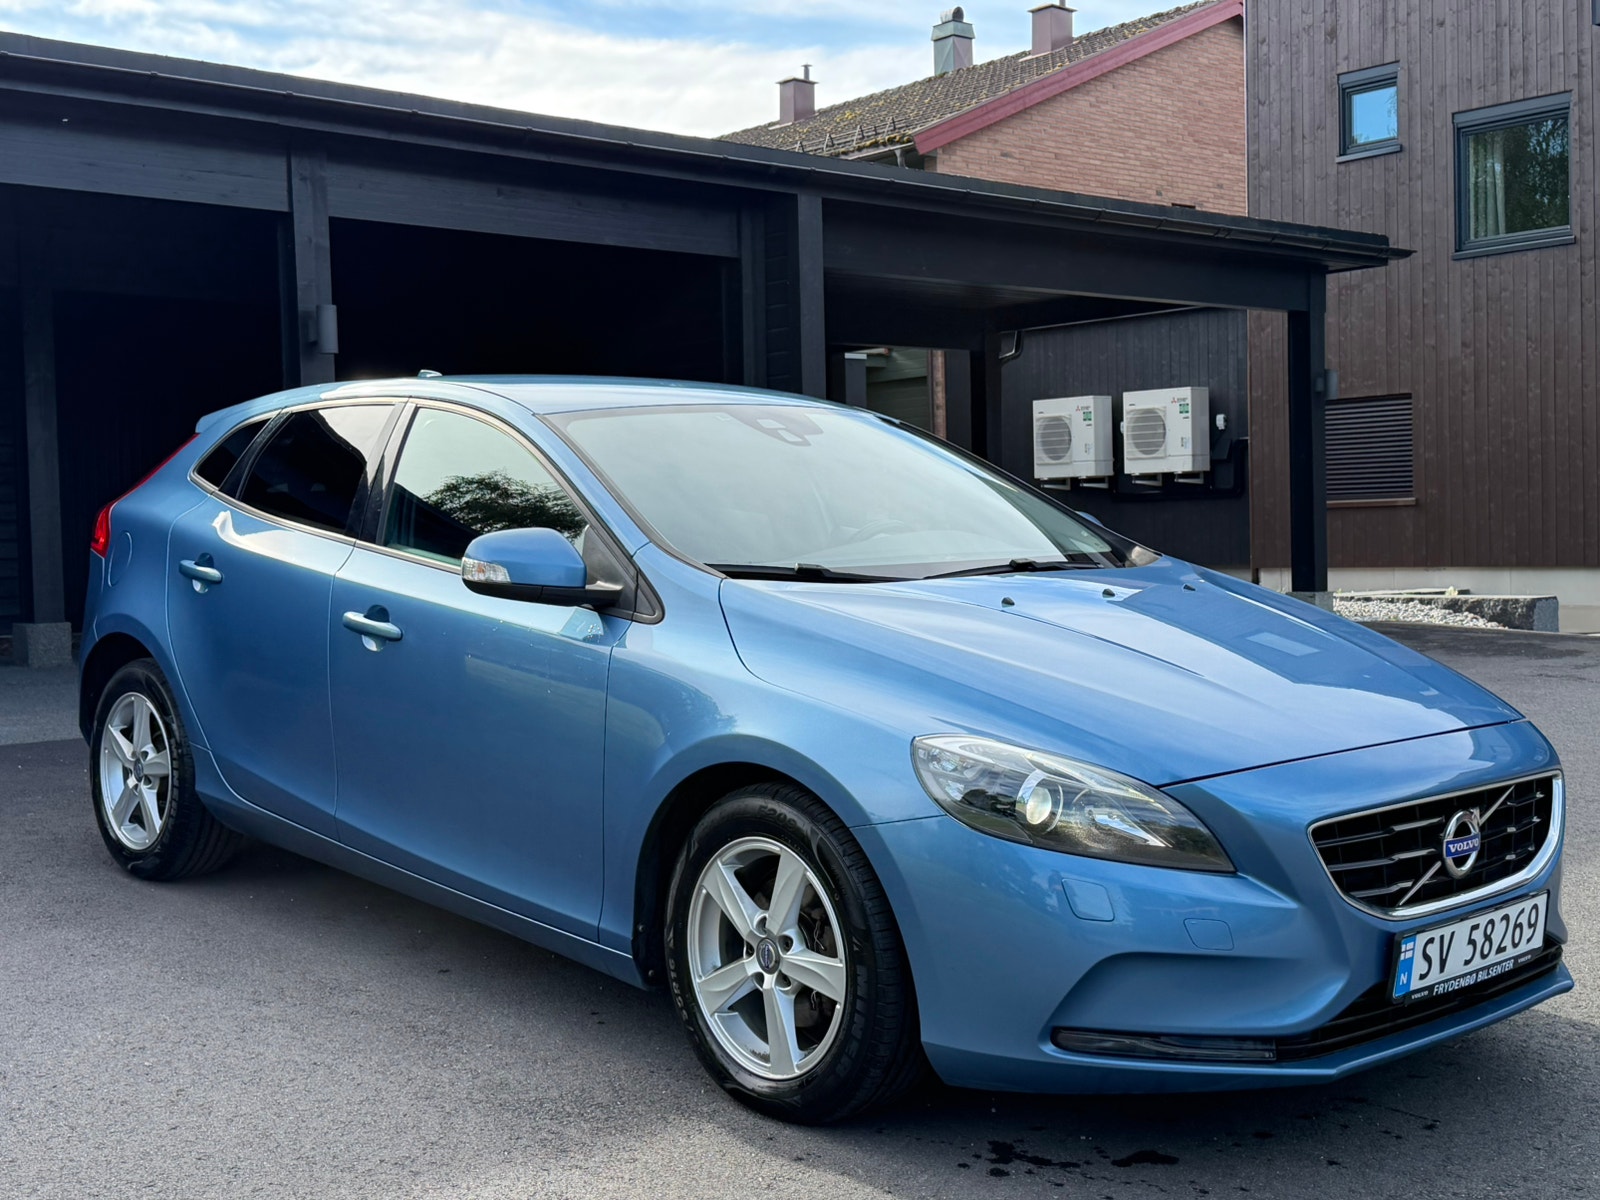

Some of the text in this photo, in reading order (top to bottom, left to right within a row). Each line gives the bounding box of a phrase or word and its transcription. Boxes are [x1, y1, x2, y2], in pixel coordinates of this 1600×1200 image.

[1448, 838, 1479, 853] VOLVO
[1418, 903, 1539, 981] SV 58269
[1400, 972, 1408, 986] N
[1433, 959, 1515, 996] FRYDENBØ BILSENTER
